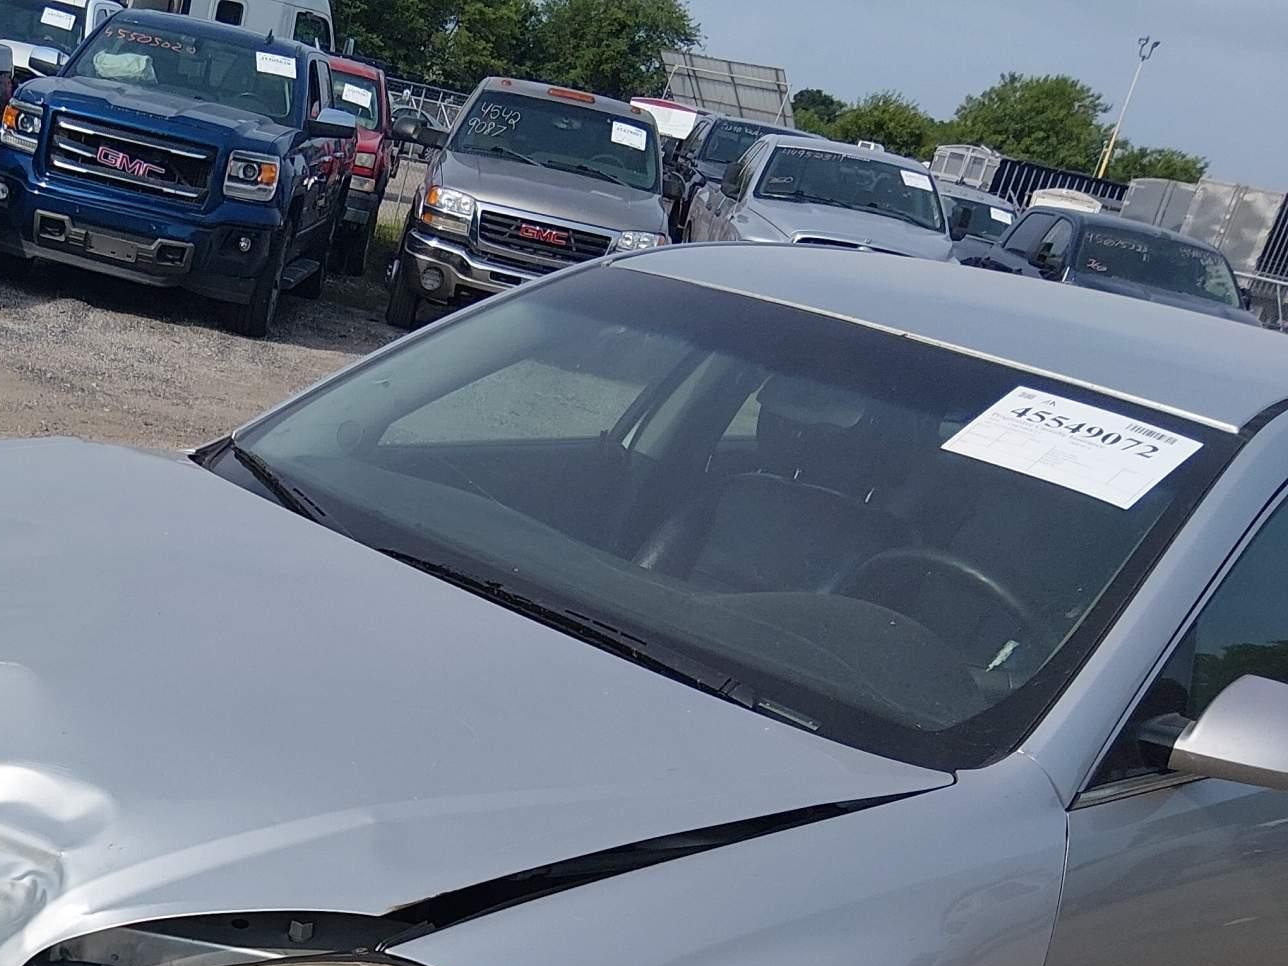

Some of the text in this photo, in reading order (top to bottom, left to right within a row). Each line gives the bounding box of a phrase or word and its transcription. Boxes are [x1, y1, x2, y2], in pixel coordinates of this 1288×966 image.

[481, 101, 521, 130] 4542
[96, 146, 166, 178] GMC
[520, 223, 569, 246] GMC
[1010, 406, 1159, 459] 45549072
